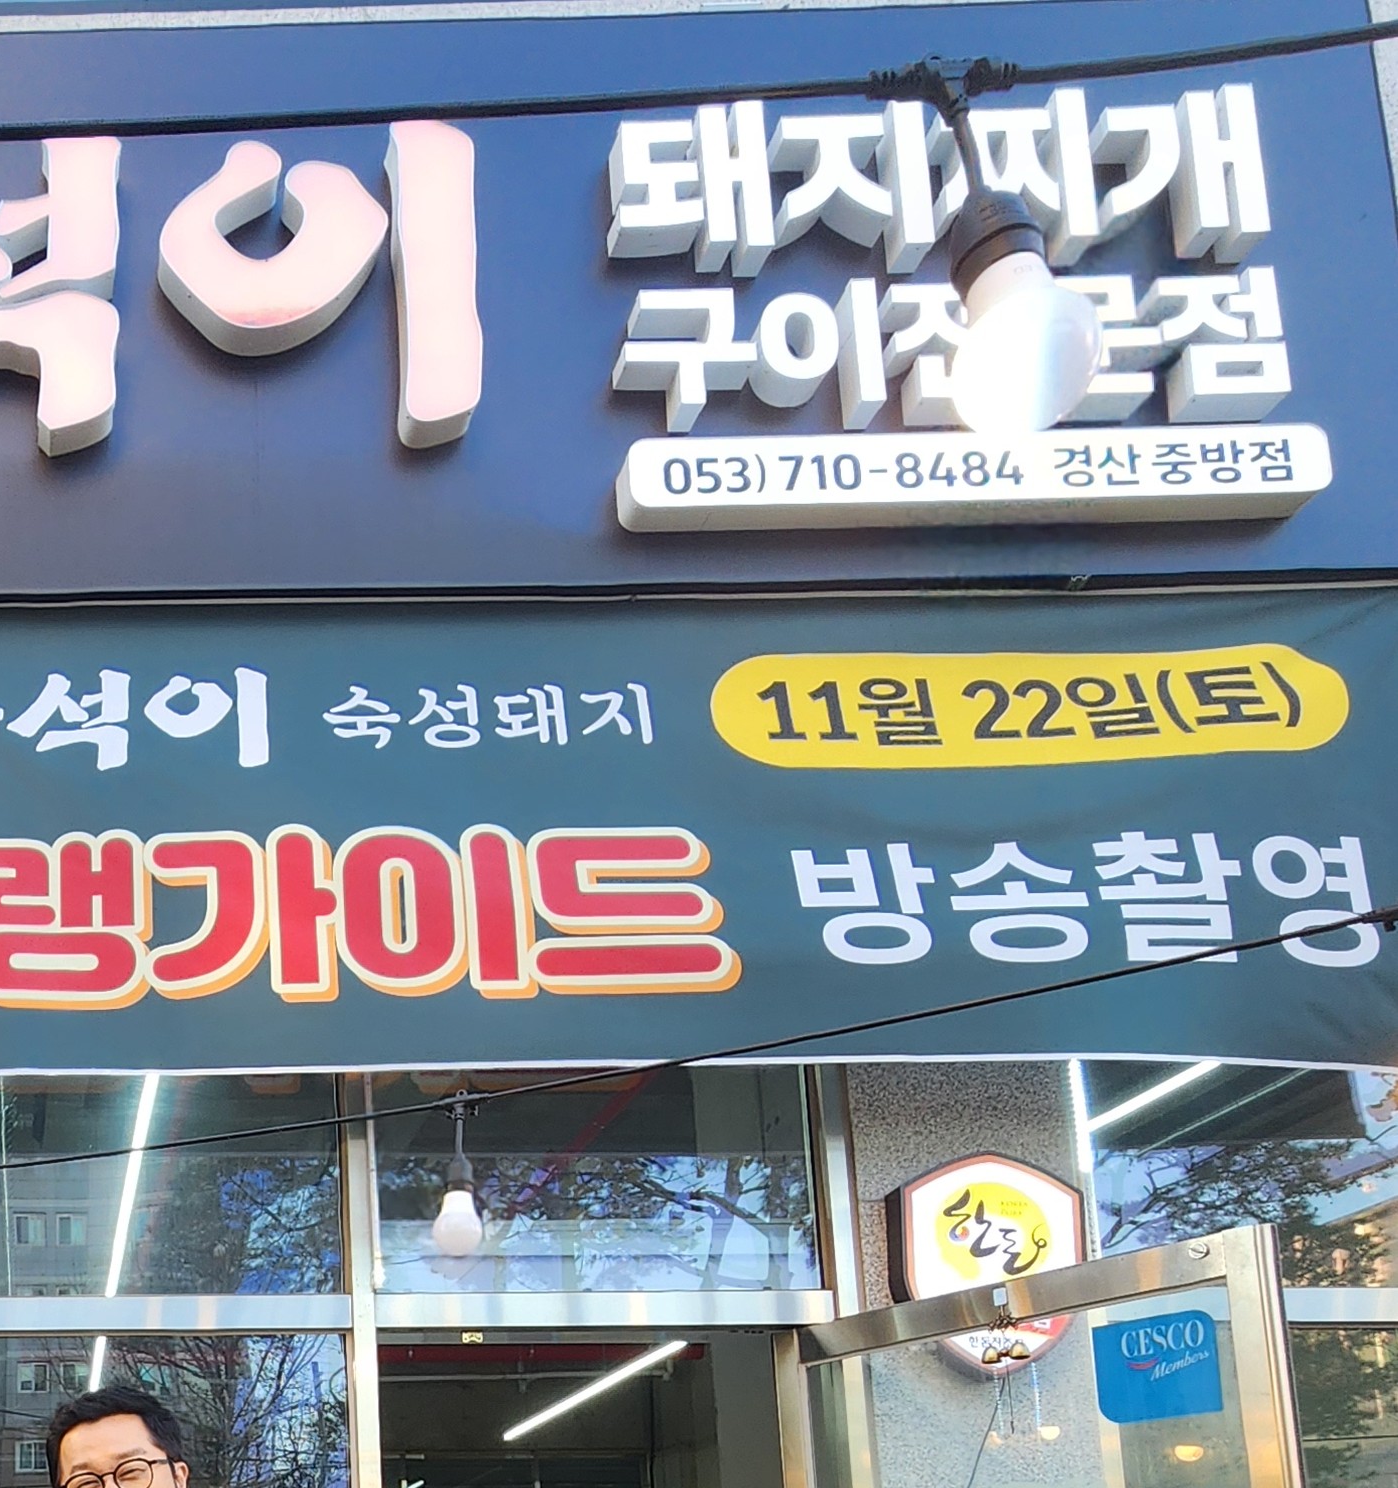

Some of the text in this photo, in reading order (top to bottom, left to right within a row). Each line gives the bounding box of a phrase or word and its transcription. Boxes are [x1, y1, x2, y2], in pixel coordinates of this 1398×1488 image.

[608, 82, 1270, 276] 돼지찌개
[1054, 445, 1140, 487] 경산
[1151, 439, 1294, 485] 중방점
[322, 683, 653, 750] 숙성돼지
[757, 660, 1302, 747] 11월 22일(토)
[790, 830, 1381, 967] 방송촬영
[1120, 1318, 1204, 1359] CESCO
[1150, 1349, 1210, 1381] Members
